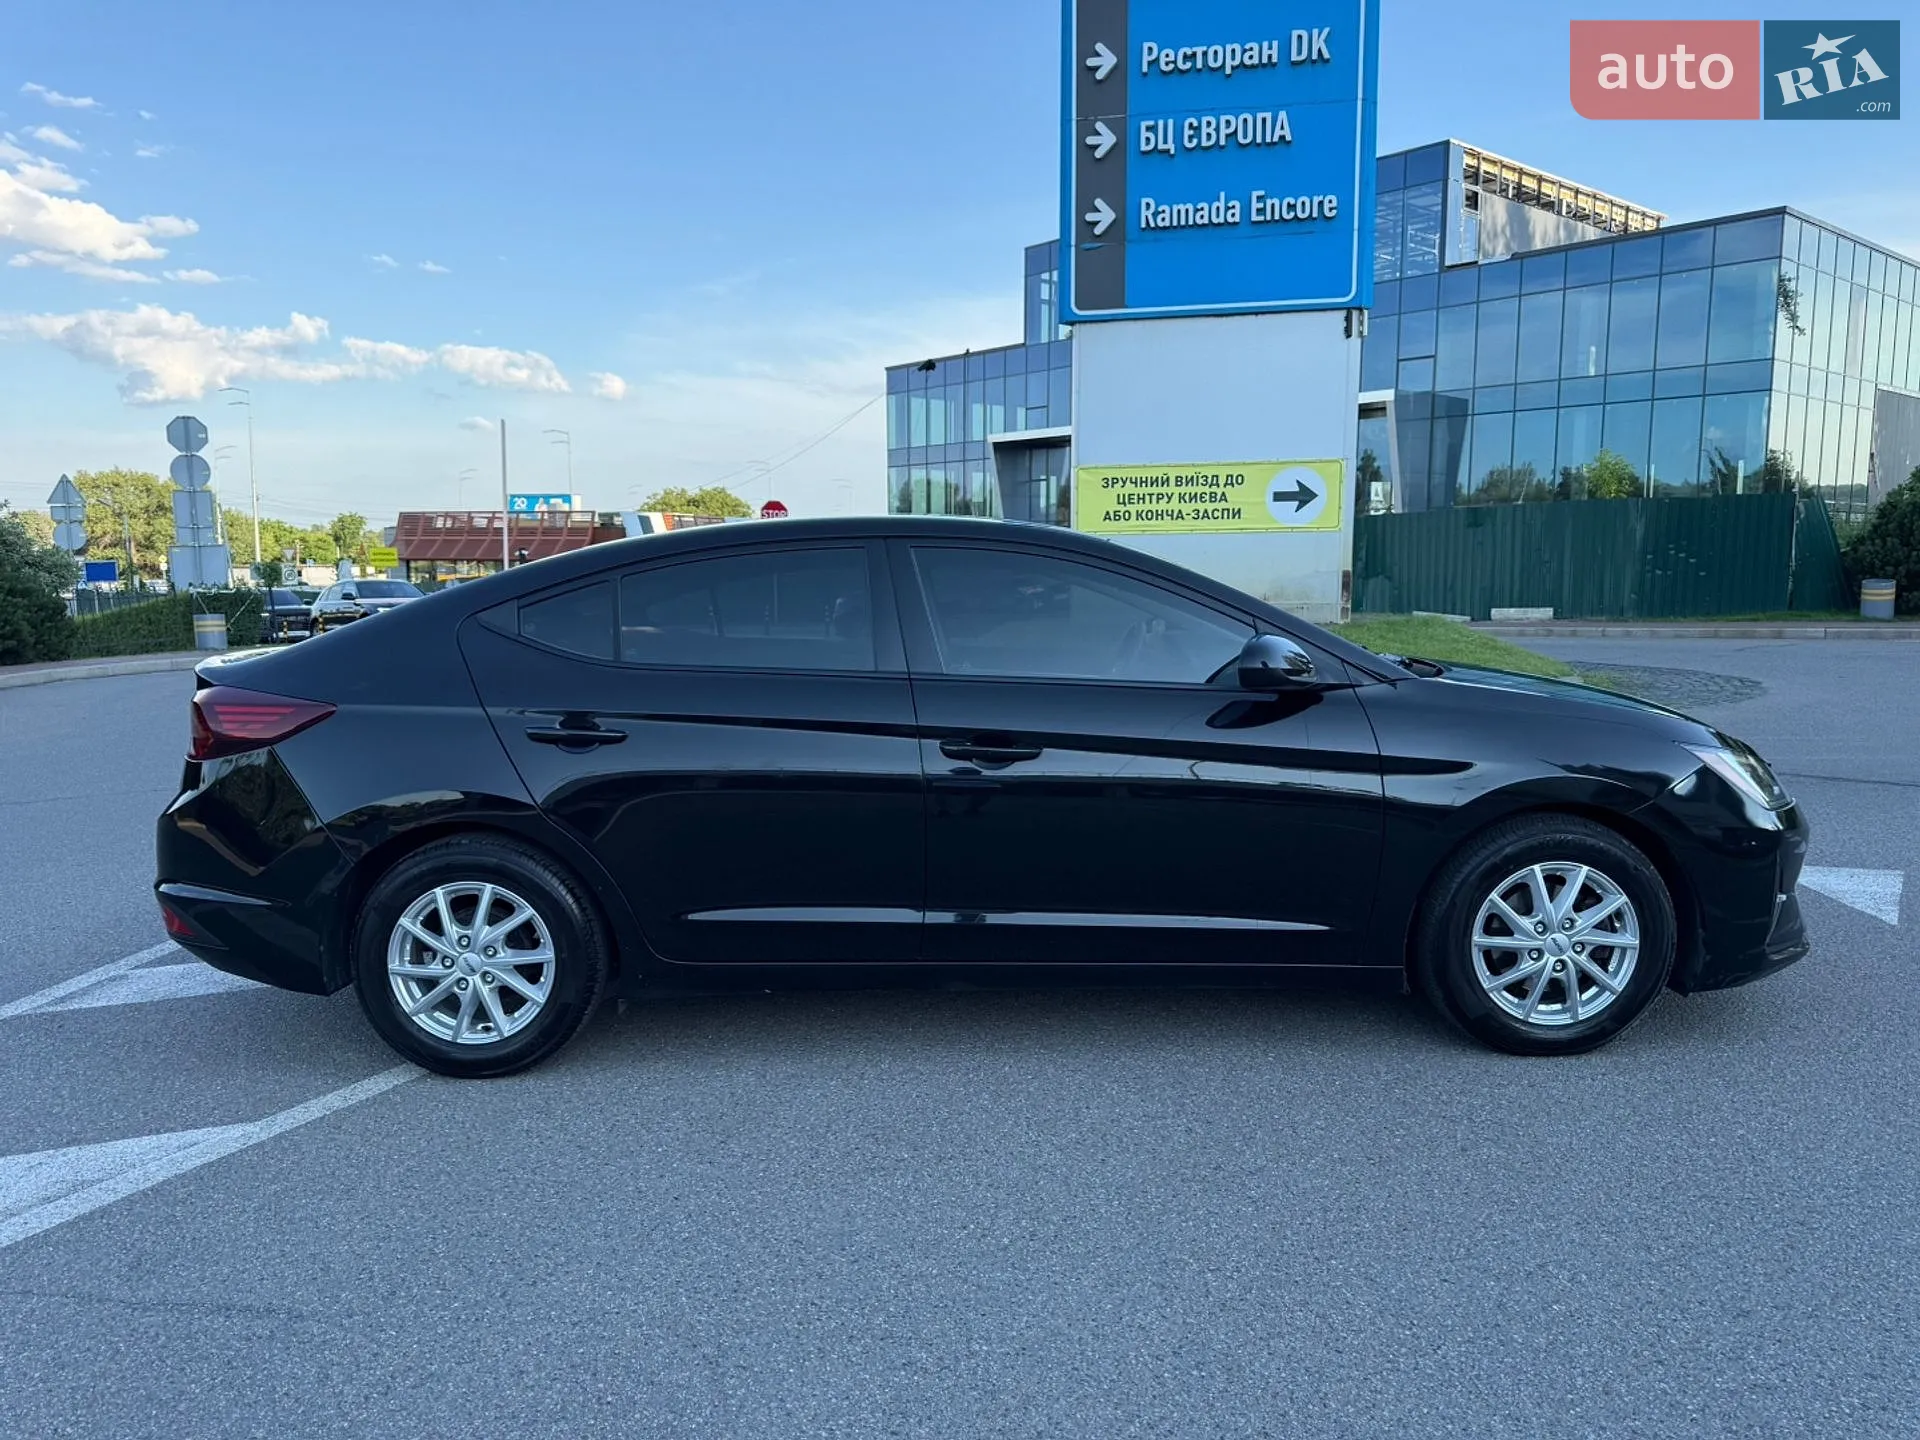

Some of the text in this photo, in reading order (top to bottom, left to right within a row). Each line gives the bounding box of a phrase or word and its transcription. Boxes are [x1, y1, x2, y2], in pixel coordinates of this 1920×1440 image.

[1141, 27, 1331, 74] Ресторан DK
[1139, 110, 1292, 154] БЦ ЄВРОПА
[1140, 190, 1338, 228] Ramada Encore
[1101, 472, 1245, 489] ЗРУЧНИЙ ВИЇЗД ДО
[1117, 491, 1228, 506] ЦЕНТРУ КИЄВА
[761, 510, 788, 519] STOP
[1103, 508, 1242, 522] АБО КОНЧА-ЗАСПИ
